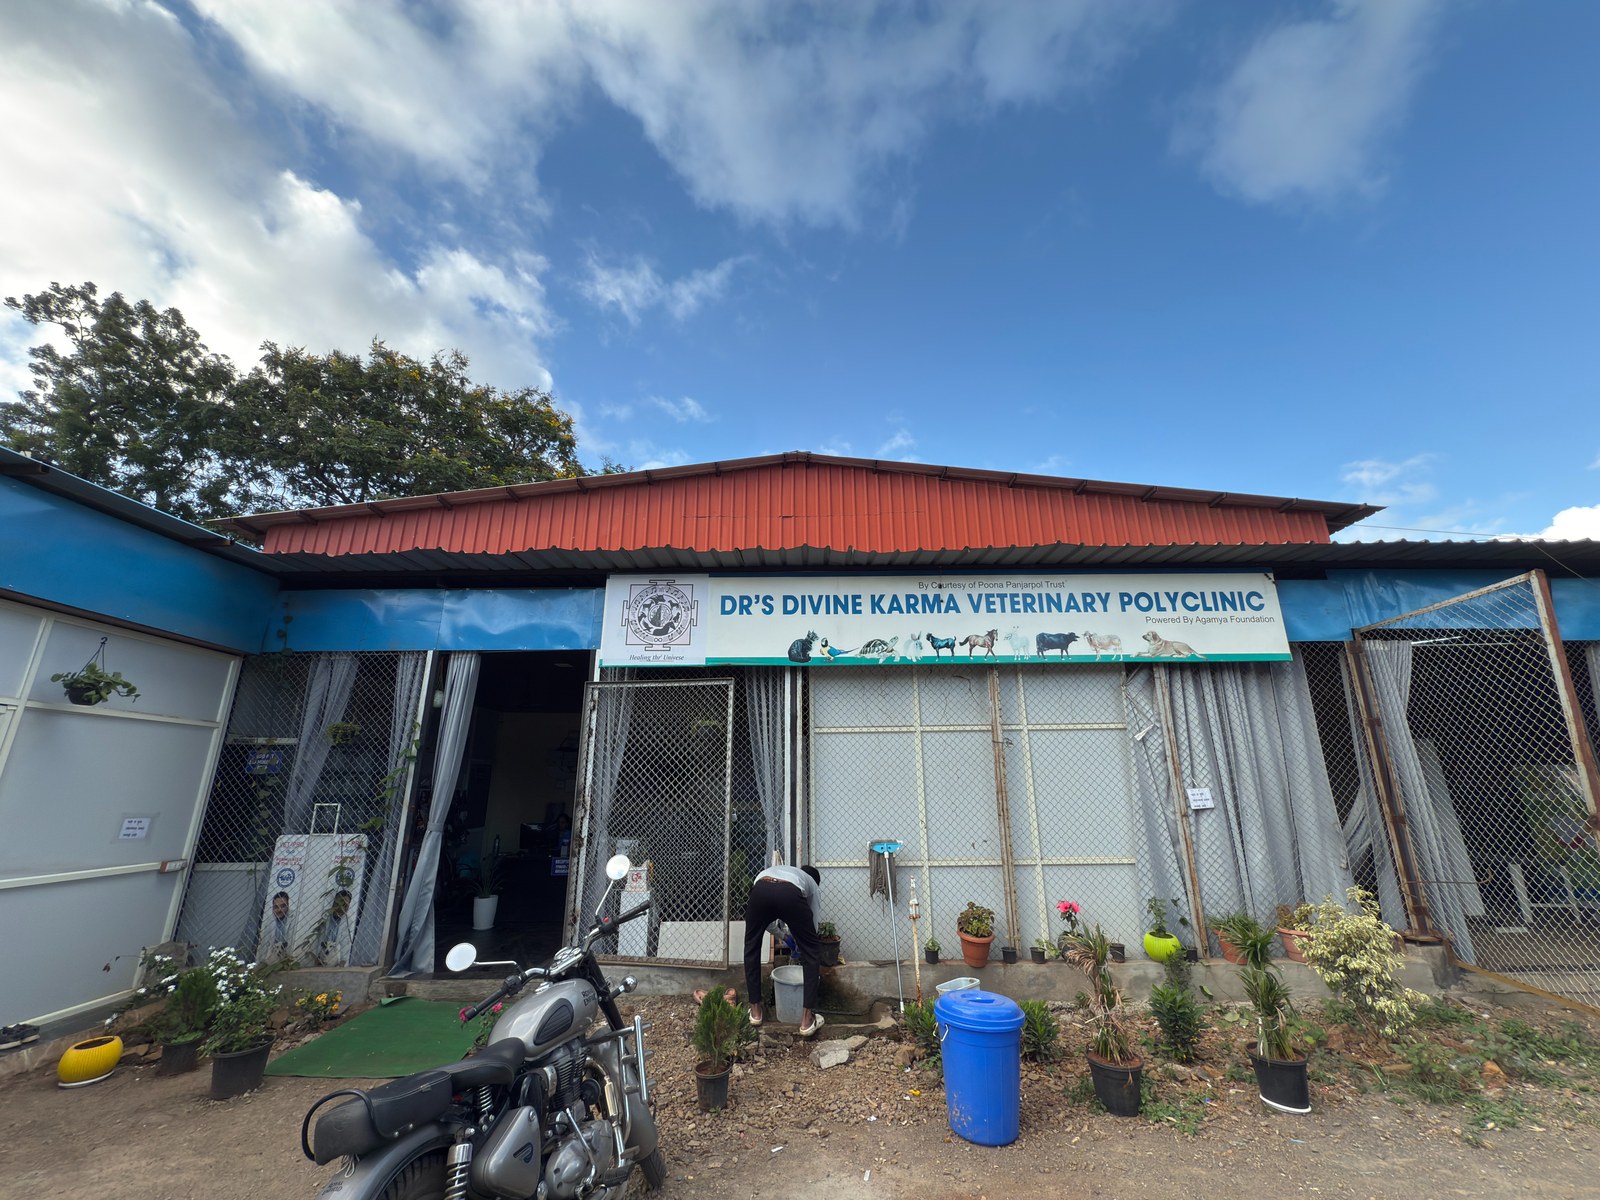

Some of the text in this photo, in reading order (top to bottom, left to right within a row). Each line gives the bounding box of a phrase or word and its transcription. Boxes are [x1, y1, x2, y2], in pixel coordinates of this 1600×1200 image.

[918, 581, 929, 590] By
[968, 581, 976, 589] of
[978, 581, 1004, 589] Poona
[1005, 581, 1043, 590] Panjarpol
[1045, 580, 1066, 588] Trust
[720, 591, 1265, 616] DR'S DIVINE KARMA VETERINARY POLYCLINIC
[1183, 616, 1193, 625] By
[1195, 616, 1228, 625] Agamya
[1230, 615, 1275, 623] Foundation
[629, 654, 651, 662] Healing
